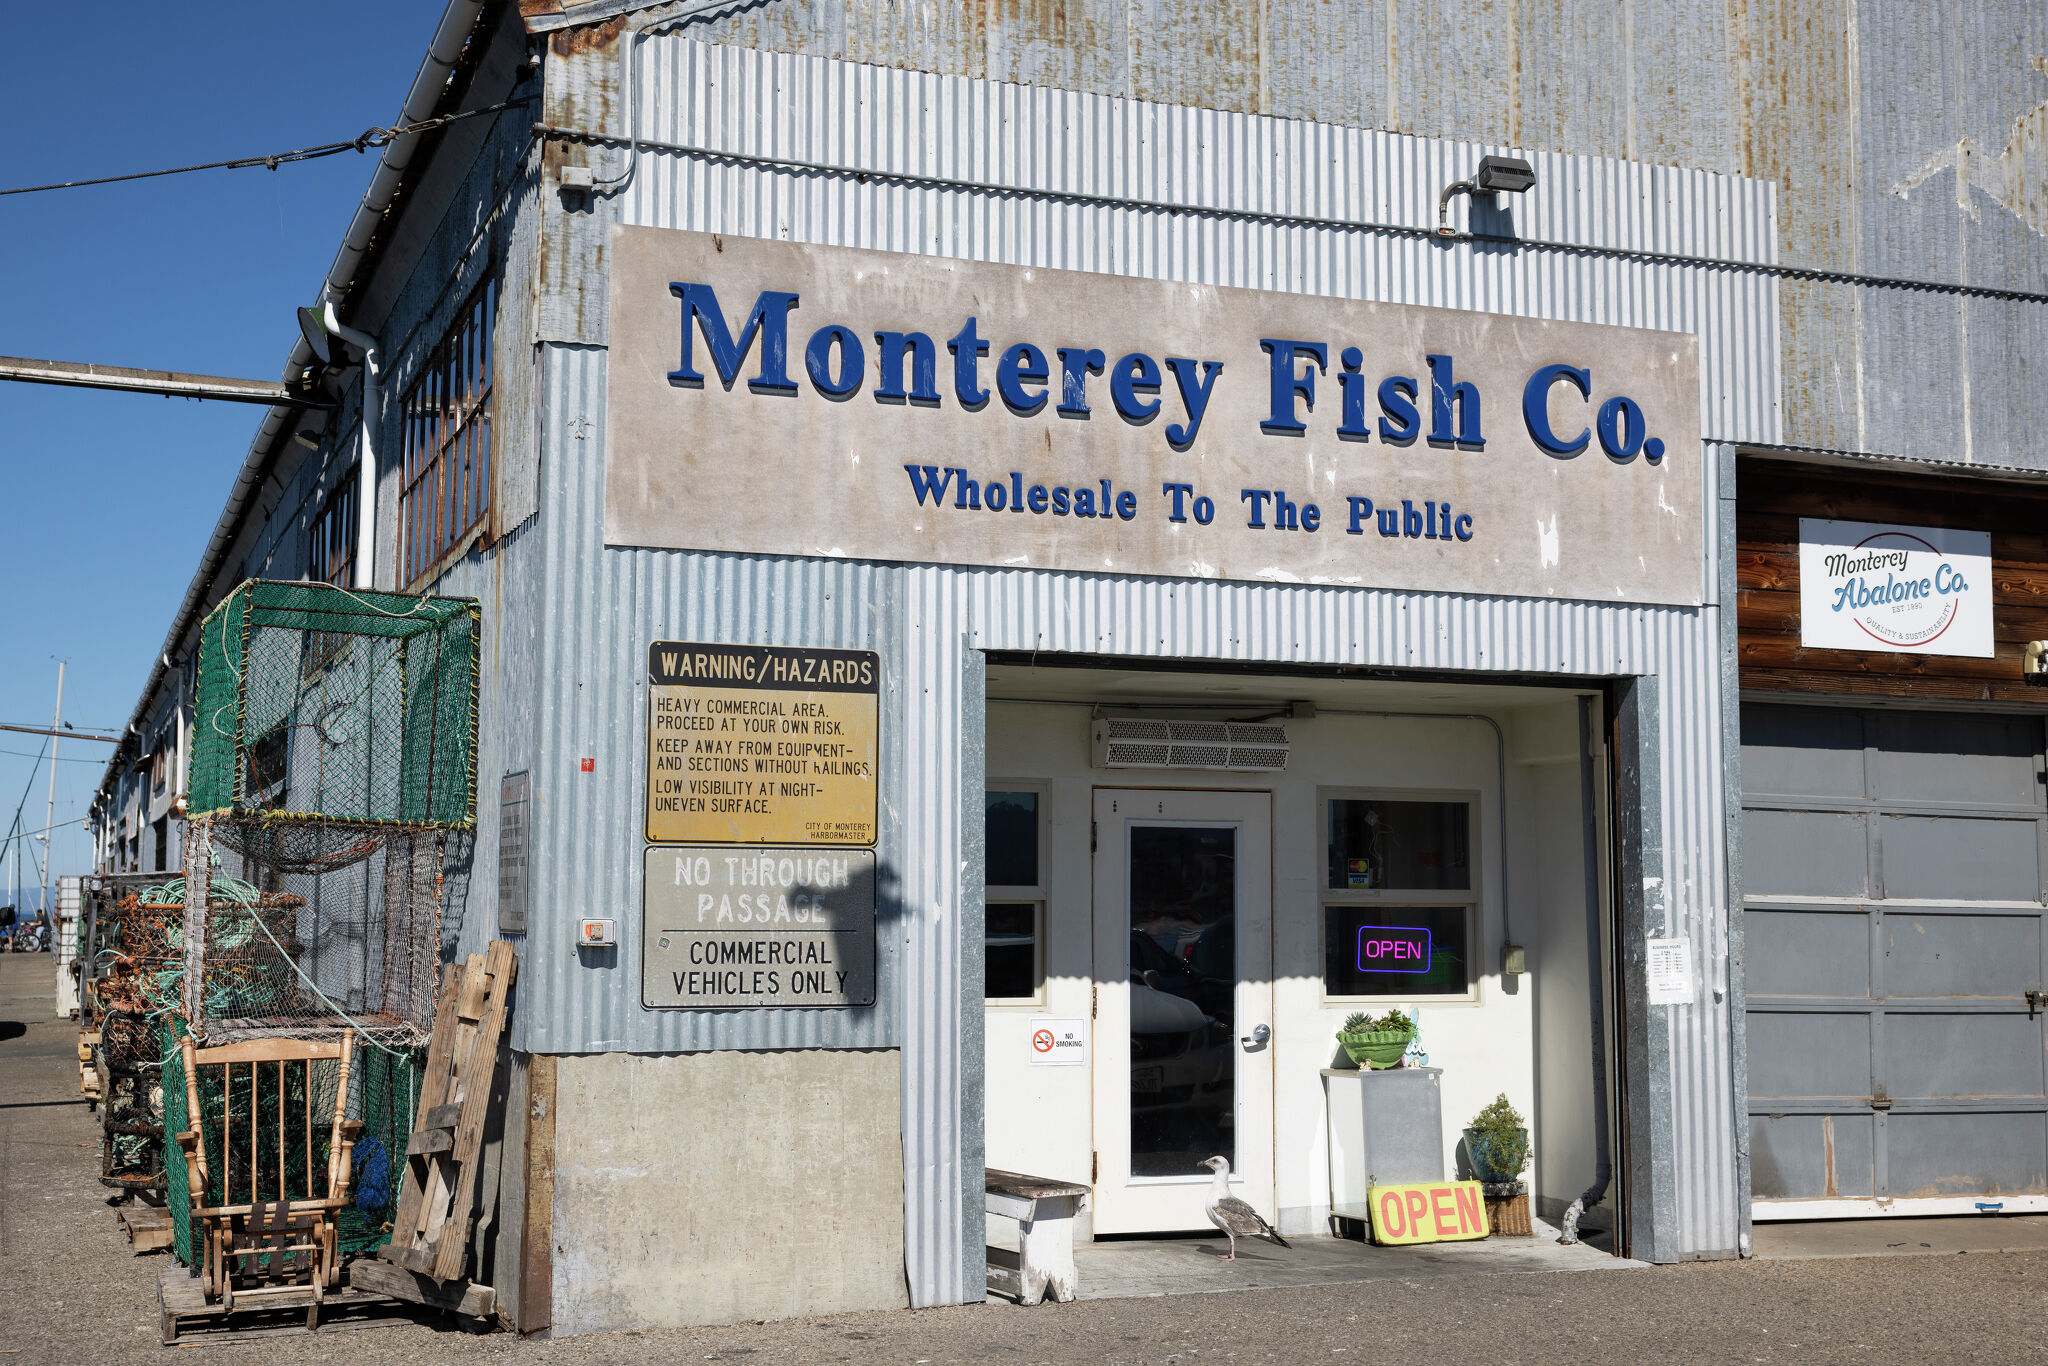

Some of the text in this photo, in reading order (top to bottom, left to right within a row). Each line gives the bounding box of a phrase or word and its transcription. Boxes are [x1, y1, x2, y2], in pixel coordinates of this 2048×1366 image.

[667, 281, 1665, 465] Monterey Fish Co.
[904, 465, 1474, 542] Wholesale To The Public
[1825, 551, 1909, 577] Monterey
[1832, 563, 1968, 612] Abalone Co.
[1866, 617, 1897, 639] QUALITY
[1905, 602, 1952, 640] SUSTAINABILITY
[1892, 605, 1905, 614] EST
[661, 652, 872, 684] WARNING/HAZARDS
[657, 698, 829, 718] HEAVY COMMERCIAL AREA.
[657, 716, 845, 736] PROCEED AT YOUR OWN RISK.
[657, 739, 689, 753] KEEP
[695, 740, 732, 754] AWAY
[739, 741, 772, 755] FROM
[657, 757, 872, 777] AND SECTIONS WITHOUT RAILINGS.
[656, 780, 683, 794] LOW
[690, 781, 753, 795] VISIBILITY
[759, 782, 775, 796] AT
[655, 797, 772, 814] UNEVEN SURFACE.
[811, 832, 866, 840] HARBORMASTER
[835, 823, 871, 831] MONTEREY
[675, 857, 848, 887] NO THROUGH
[697, 894, 826, 923] PASSAGE
[690, 941, 832, 964] COMMERCIAL
[1367, 941, 1421, 959] OPEN
[673, 971, 848, 995] VEHICLES ONLY
[1381, 1187, 1482, 1237] OPEN
